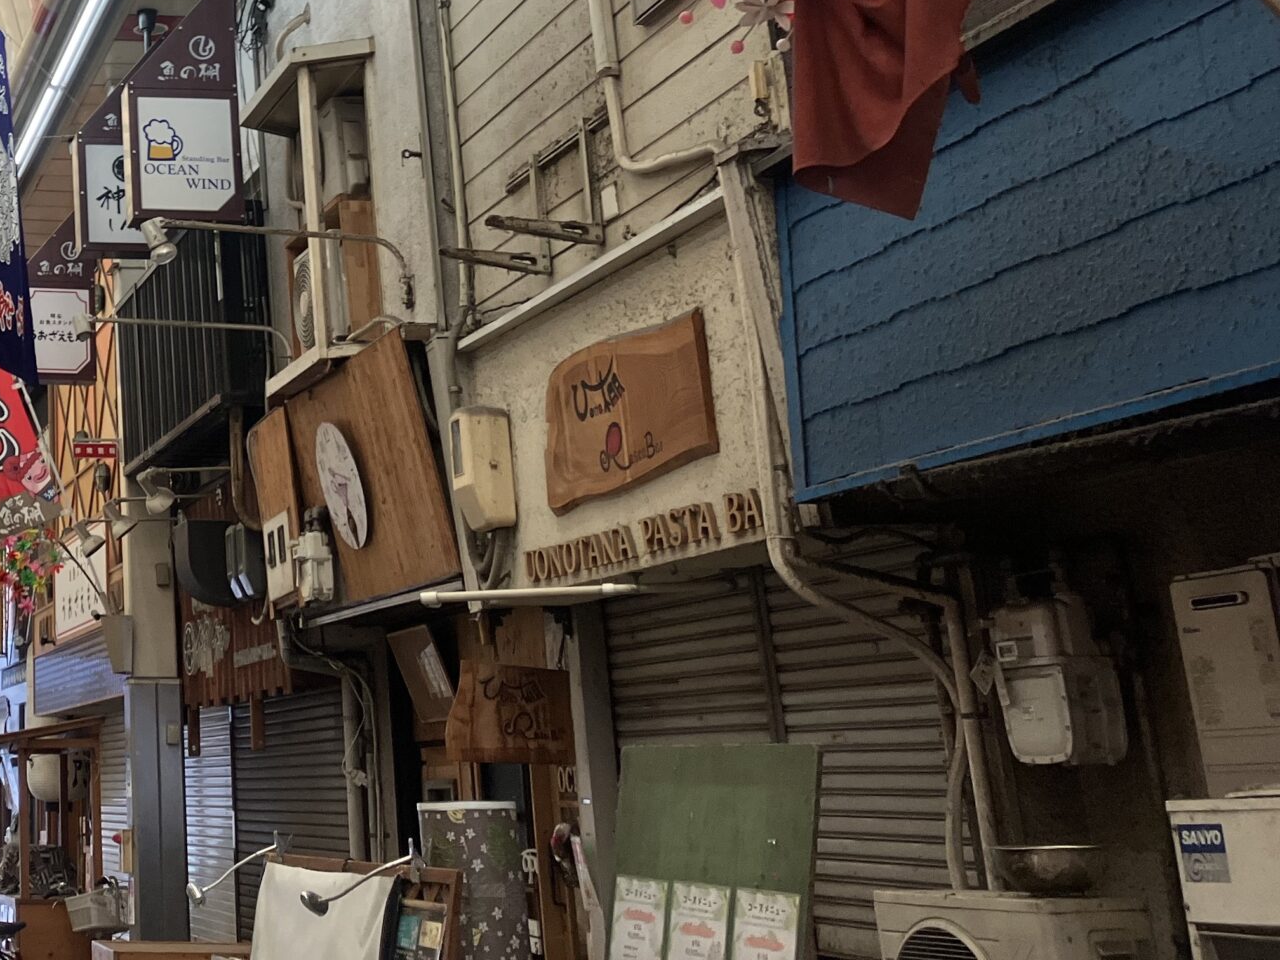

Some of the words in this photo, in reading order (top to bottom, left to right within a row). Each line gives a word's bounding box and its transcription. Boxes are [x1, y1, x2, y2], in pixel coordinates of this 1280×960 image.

[157, 60, 221, 81] 魚の棚
[182, 155, 211, 163] Standing
[144, 163, 200, 176] OCEAN
[186, 177, 232, 191] WIND
[37, 261, 83, 276] 魚の棚
[524, 524, 638, 583] UONOTANA
[639, 502, 720, 555] PASTA
[1182, 830, 1222, 846] SANYO
[747, 903, 787, 916] コースメニュー
